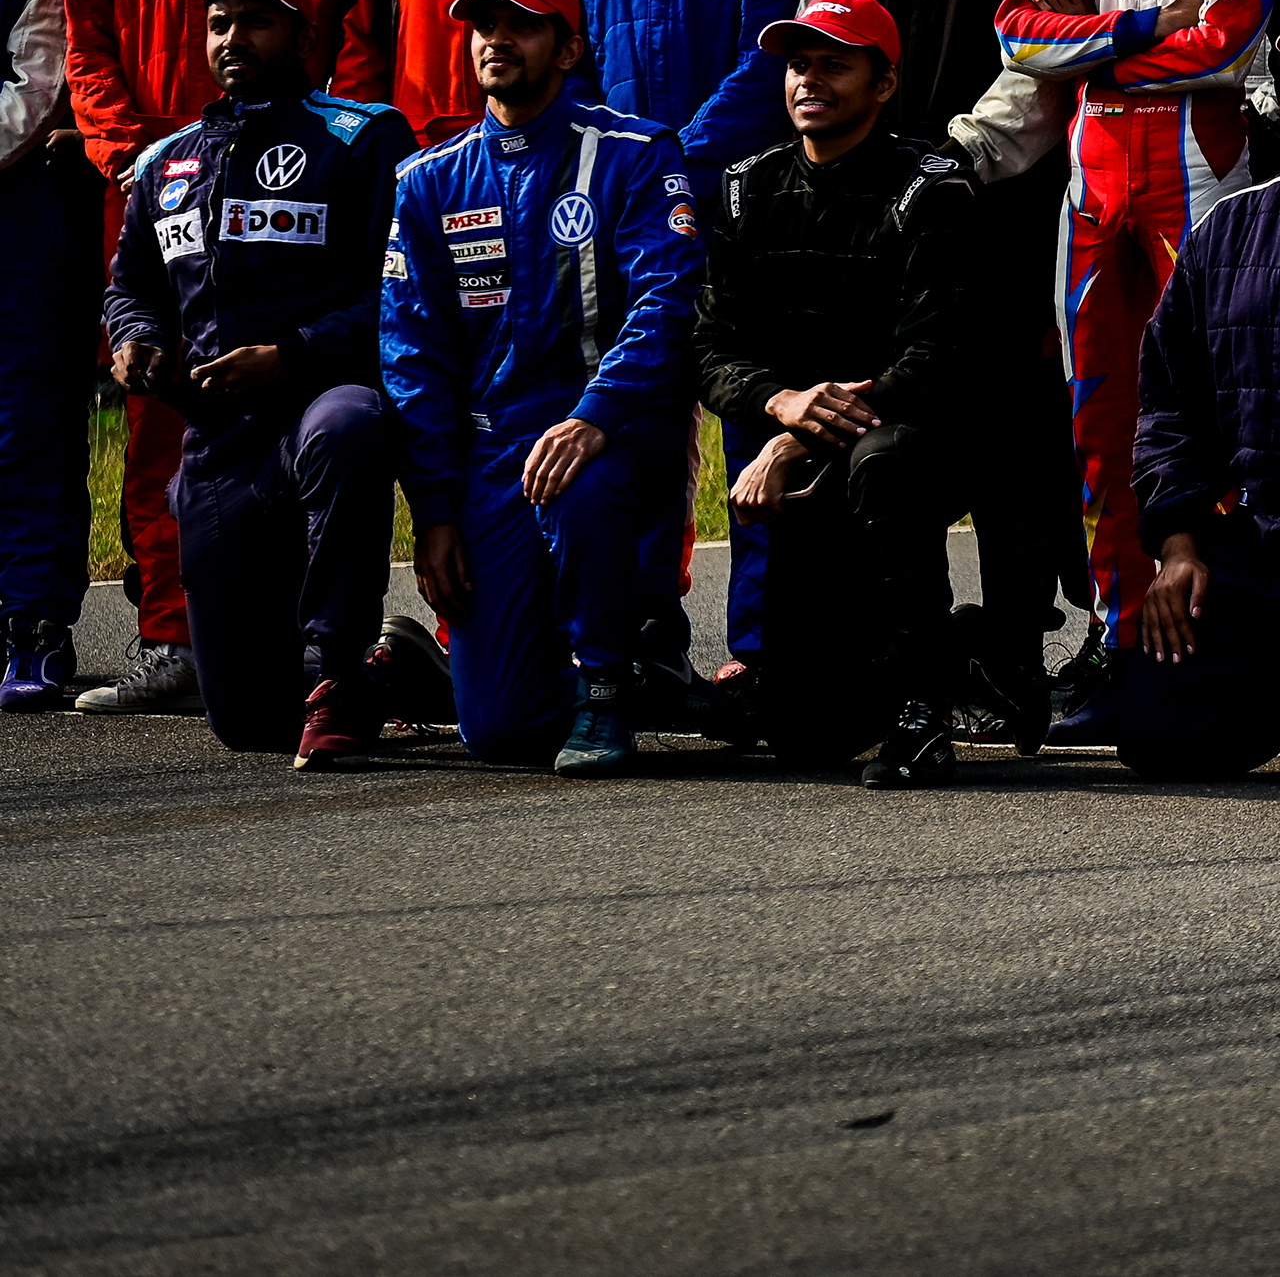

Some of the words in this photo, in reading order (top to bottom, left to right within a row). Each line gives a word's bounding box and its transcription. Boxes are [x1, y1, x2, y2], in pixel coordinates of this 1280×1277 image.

[1086, 105, 1103, 114] OMP
[335, 114, 360, 128] OMP
[501, 138, 526, 152] OMP
[899, 176, 926, 211] sparco
[445, 211, 499, 231] MRF
[459, 275, 503, 287] SONY
